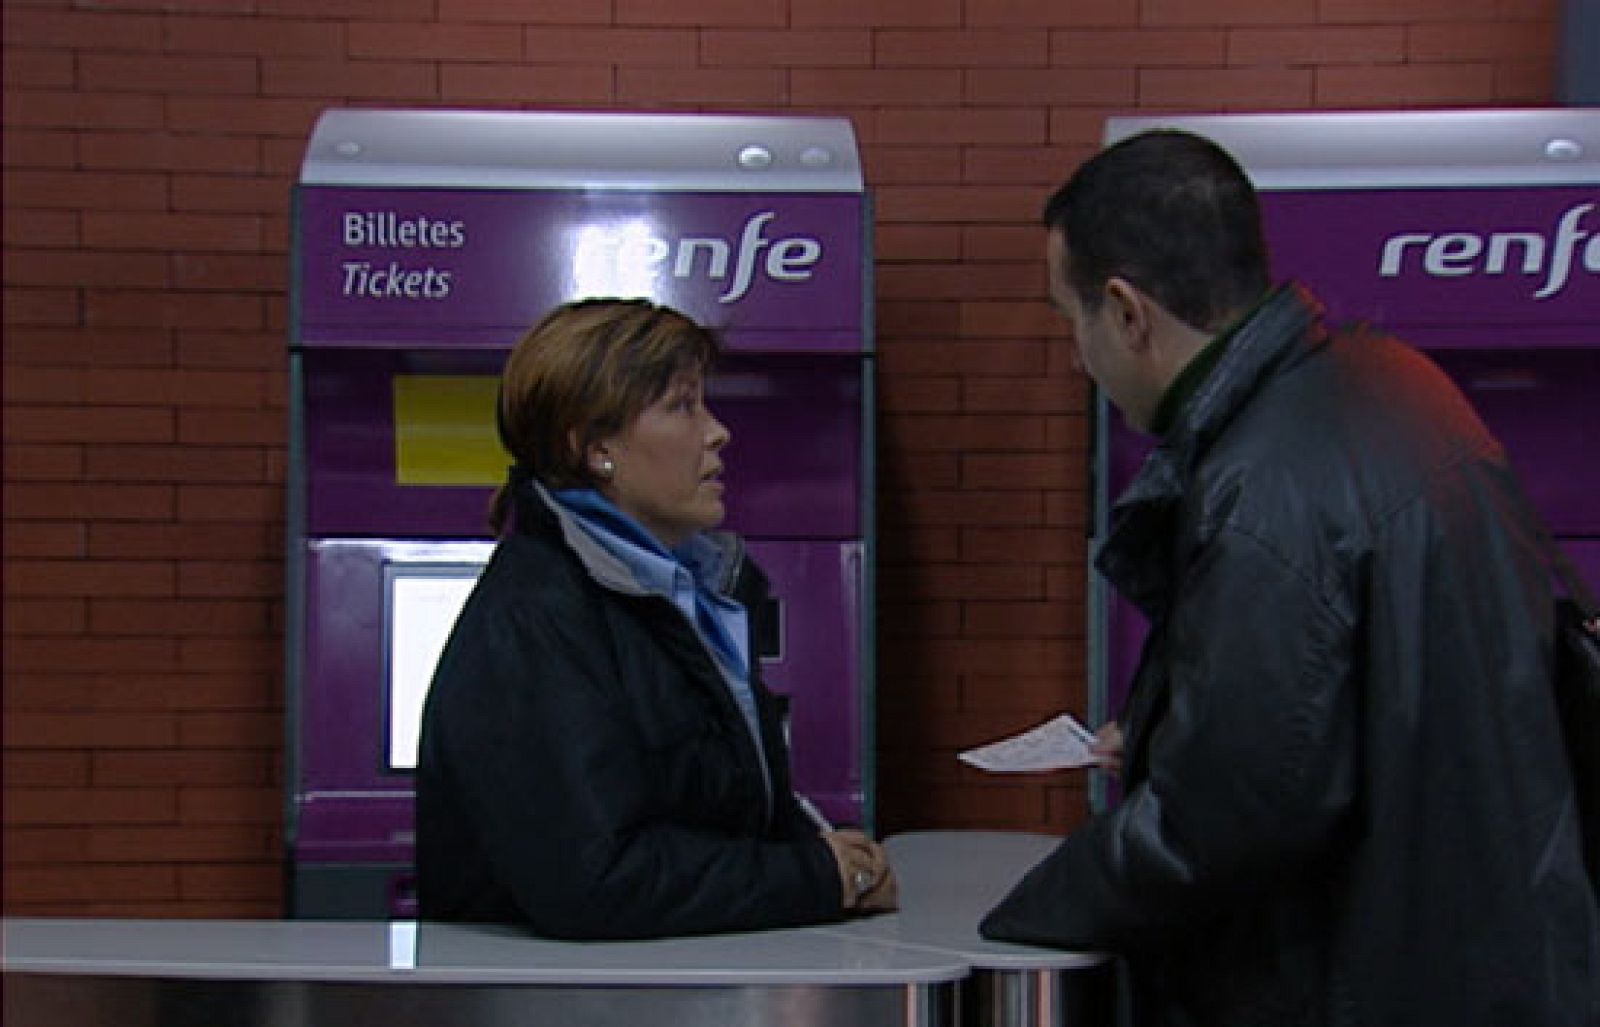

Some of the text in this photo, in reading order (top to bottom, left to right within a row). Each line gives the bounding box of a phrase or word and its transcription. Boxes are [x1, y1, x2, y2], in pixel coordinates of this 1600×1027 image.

[343, 212, 465, 248] Billetes
[578, 211, 822, 304] enfe
[341, 263, 451, 298] Tickets
